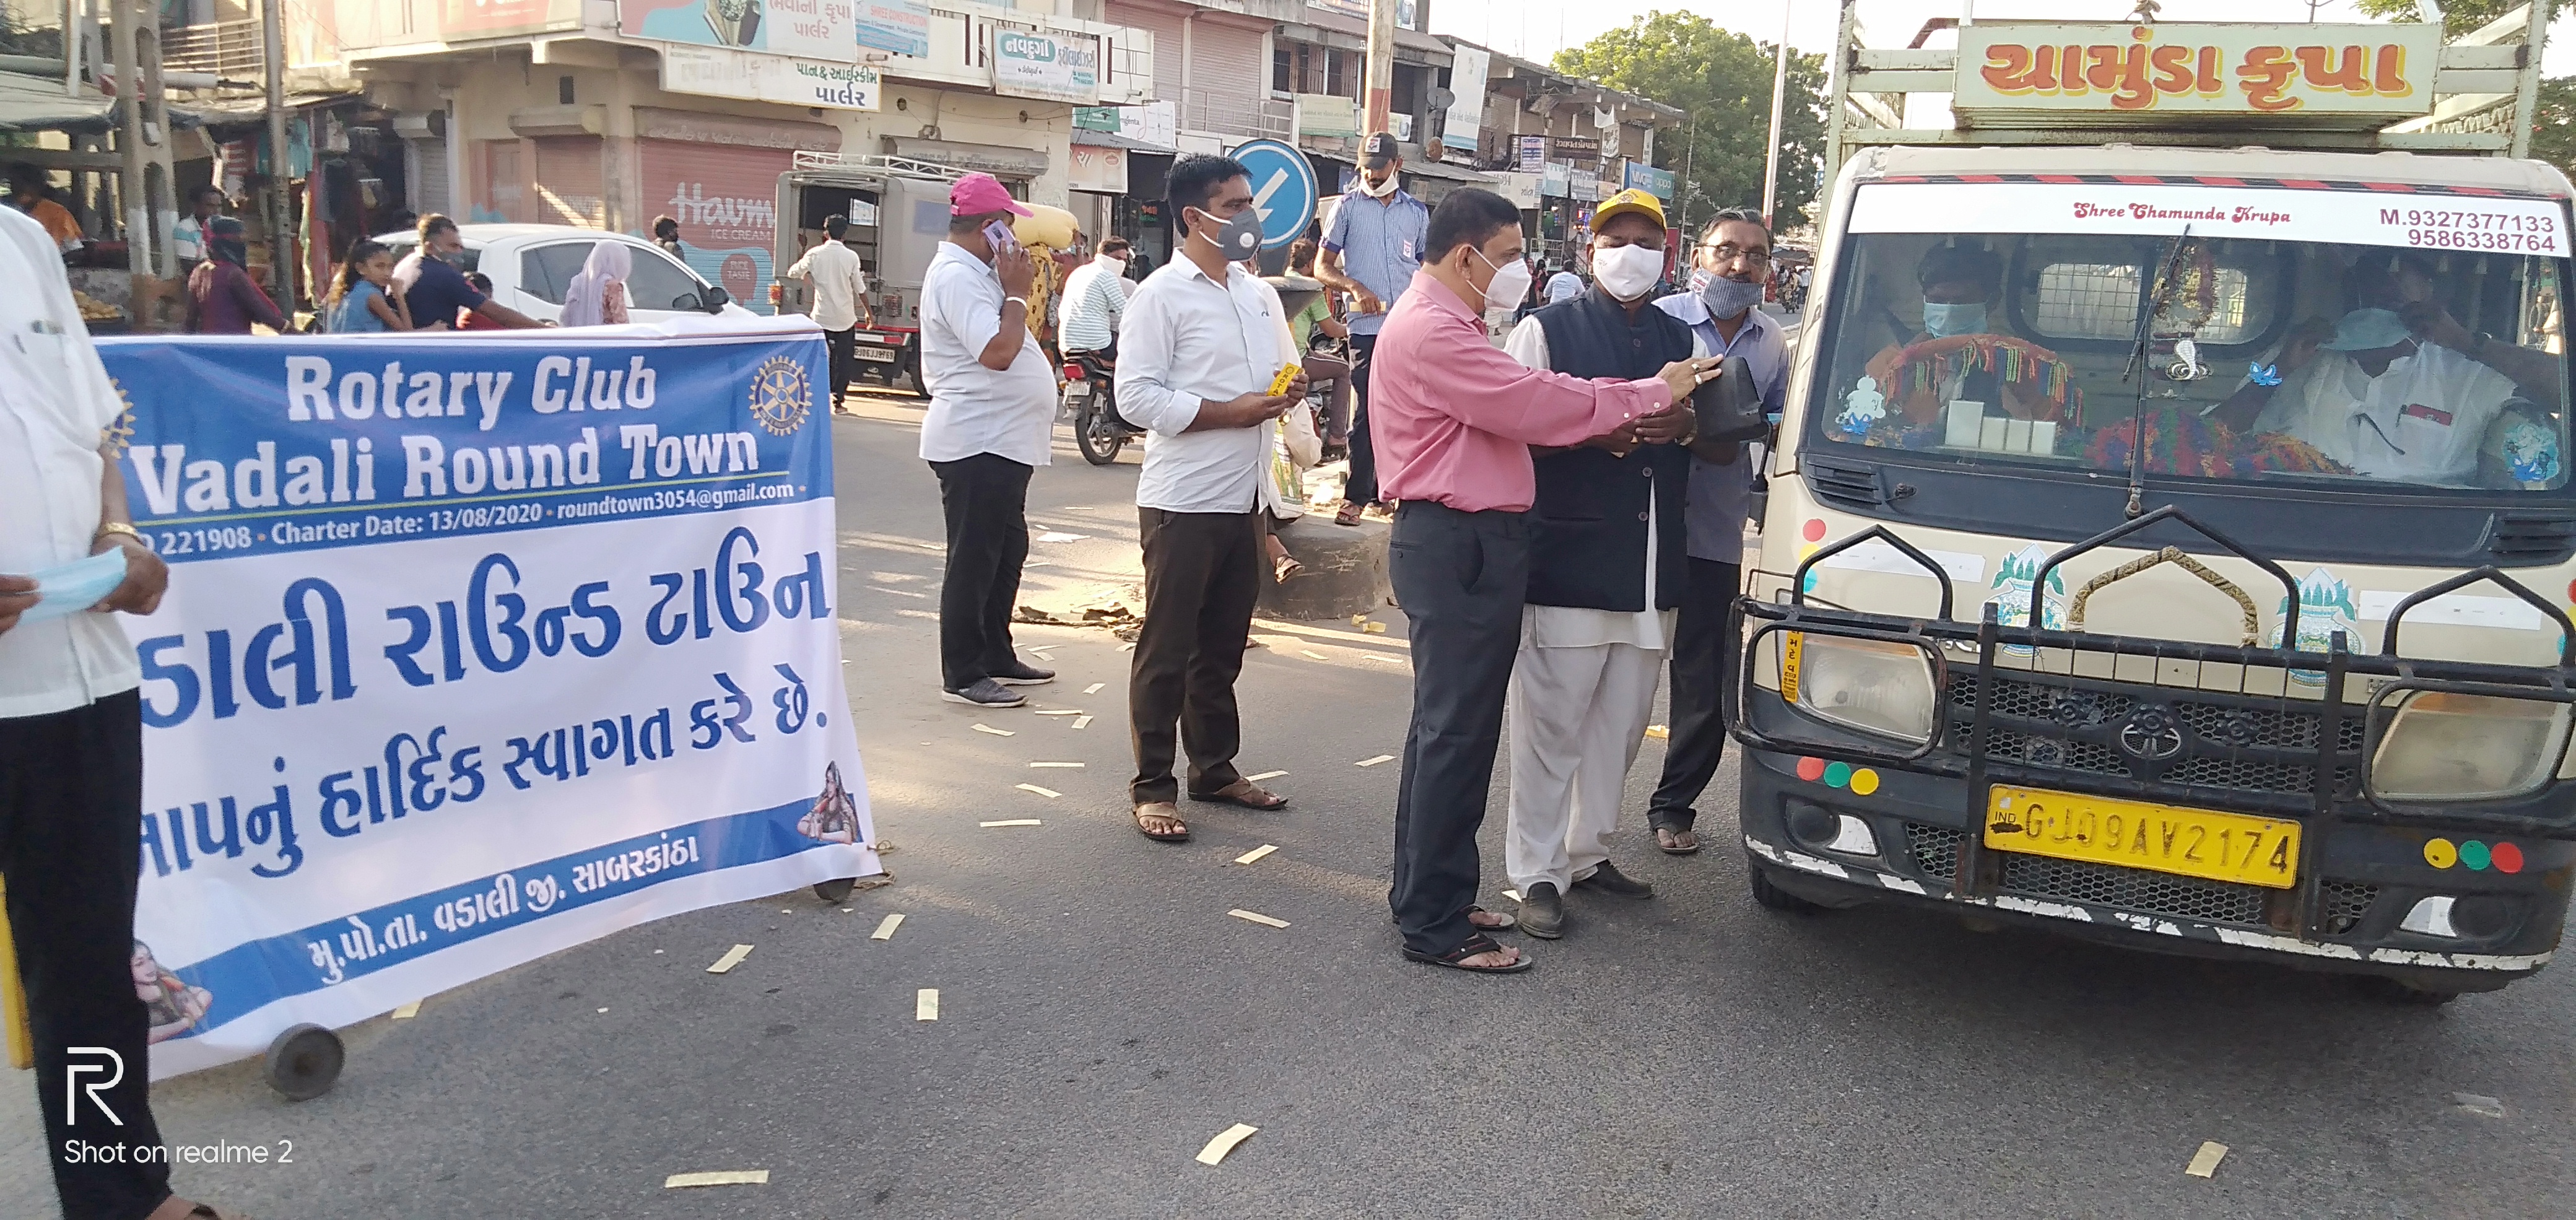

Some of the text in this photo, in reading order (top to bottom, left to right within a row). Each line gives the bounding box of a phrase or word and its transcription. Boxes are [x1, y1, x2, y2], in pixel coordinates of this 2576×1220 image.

[824, 3, 850, 24] કૃપા
[793, 19, 830, 39] પાર્લર
[796, 63, 818, 77] પાન
[1980, 25, 2414, 111] ચામુંડા કૃપા
[816, 81, 866, 107] પાર્લર
[669, 182, 775, 228] Havm
[2074, 202, 2291, 225] Shree Chamunda Krupa
[2380, 209, 2554, 233] M.9327377133
[711, 229, 771, 241] ICE CREAM
[2408, 229, 2556, 252] 9586338764
[727, 271, 751, 280] TASTE
[285, 355, 656, 432] Rotary Club
[129, 424, 759, 515] Vadali Round Town
[160, 525, 253, 555] 221908
[271, 521, 361, 545] Charter
[365, 514, 424, 537] Date:
[429, 503, 542, 531] 13/08/2020
[557, 482, 795, 520] roundtown3054@gmail.com
[136, 525, 832, 729] ડાલી રાઉન્ડ ટાઉન
[318, 726, 486, 839] હાર્દિક
[503, 706, 675, 790] સ્વાગત
[689, 673, 755, 751] કરે
[773, 663, 829, 736] છે.
[1995, 811, 2017, 824] IND
[2024, 803, 2291, 875] GJ09AV2174
[433, 873, 520, 933] વડાલી
[525, 874, 566, 912] જી.
[572, 832, 700, 894] સાબરકાંઠા
